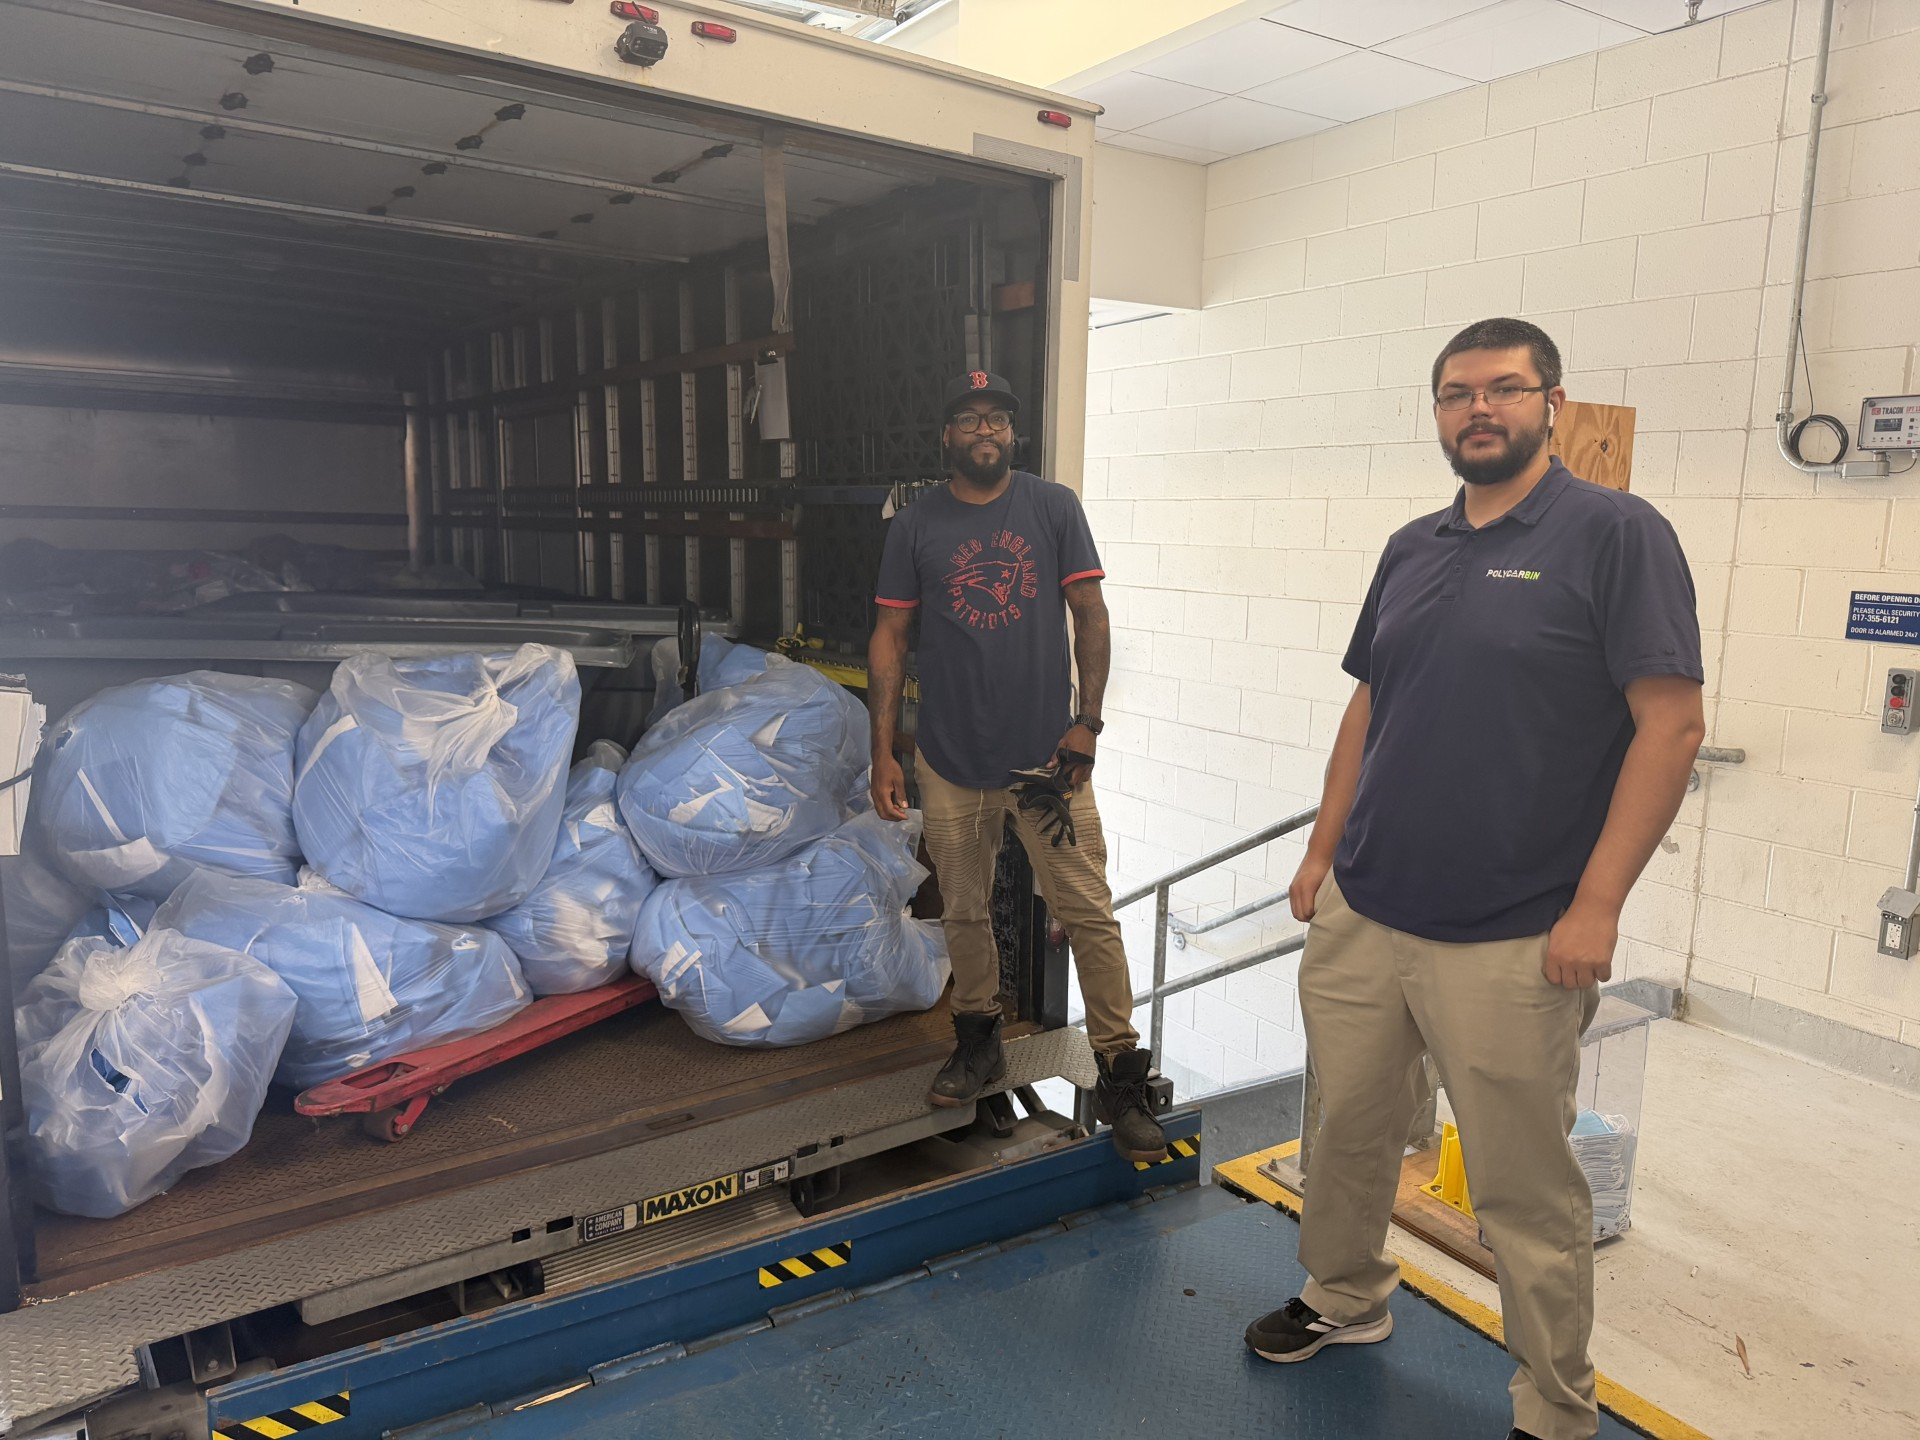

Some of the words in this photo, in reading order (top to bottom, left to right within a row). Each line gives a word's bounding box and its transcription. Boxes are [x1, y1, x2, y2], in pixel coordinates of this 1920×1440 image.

[969, 371, 988, 389] B
[950, 538, 982, 568] NEW
[991, 530, 1037, 598] ENGLAND
[1486, 569, 1541, 580] POLYCARBIN
[1854, 593, 1880, 601] BEFORE
[1881, 595, 1913, 603] OPENING
[947, 586, 1021, 629] PATRIOTS
[1852, 614, 1899, 624] 617-355-6121
[646, 1177, 732, 1221] MAXON
[595, 1210, 623, 1223] AMERICAN
[595, 1217, 622, 1232] COMPANY
